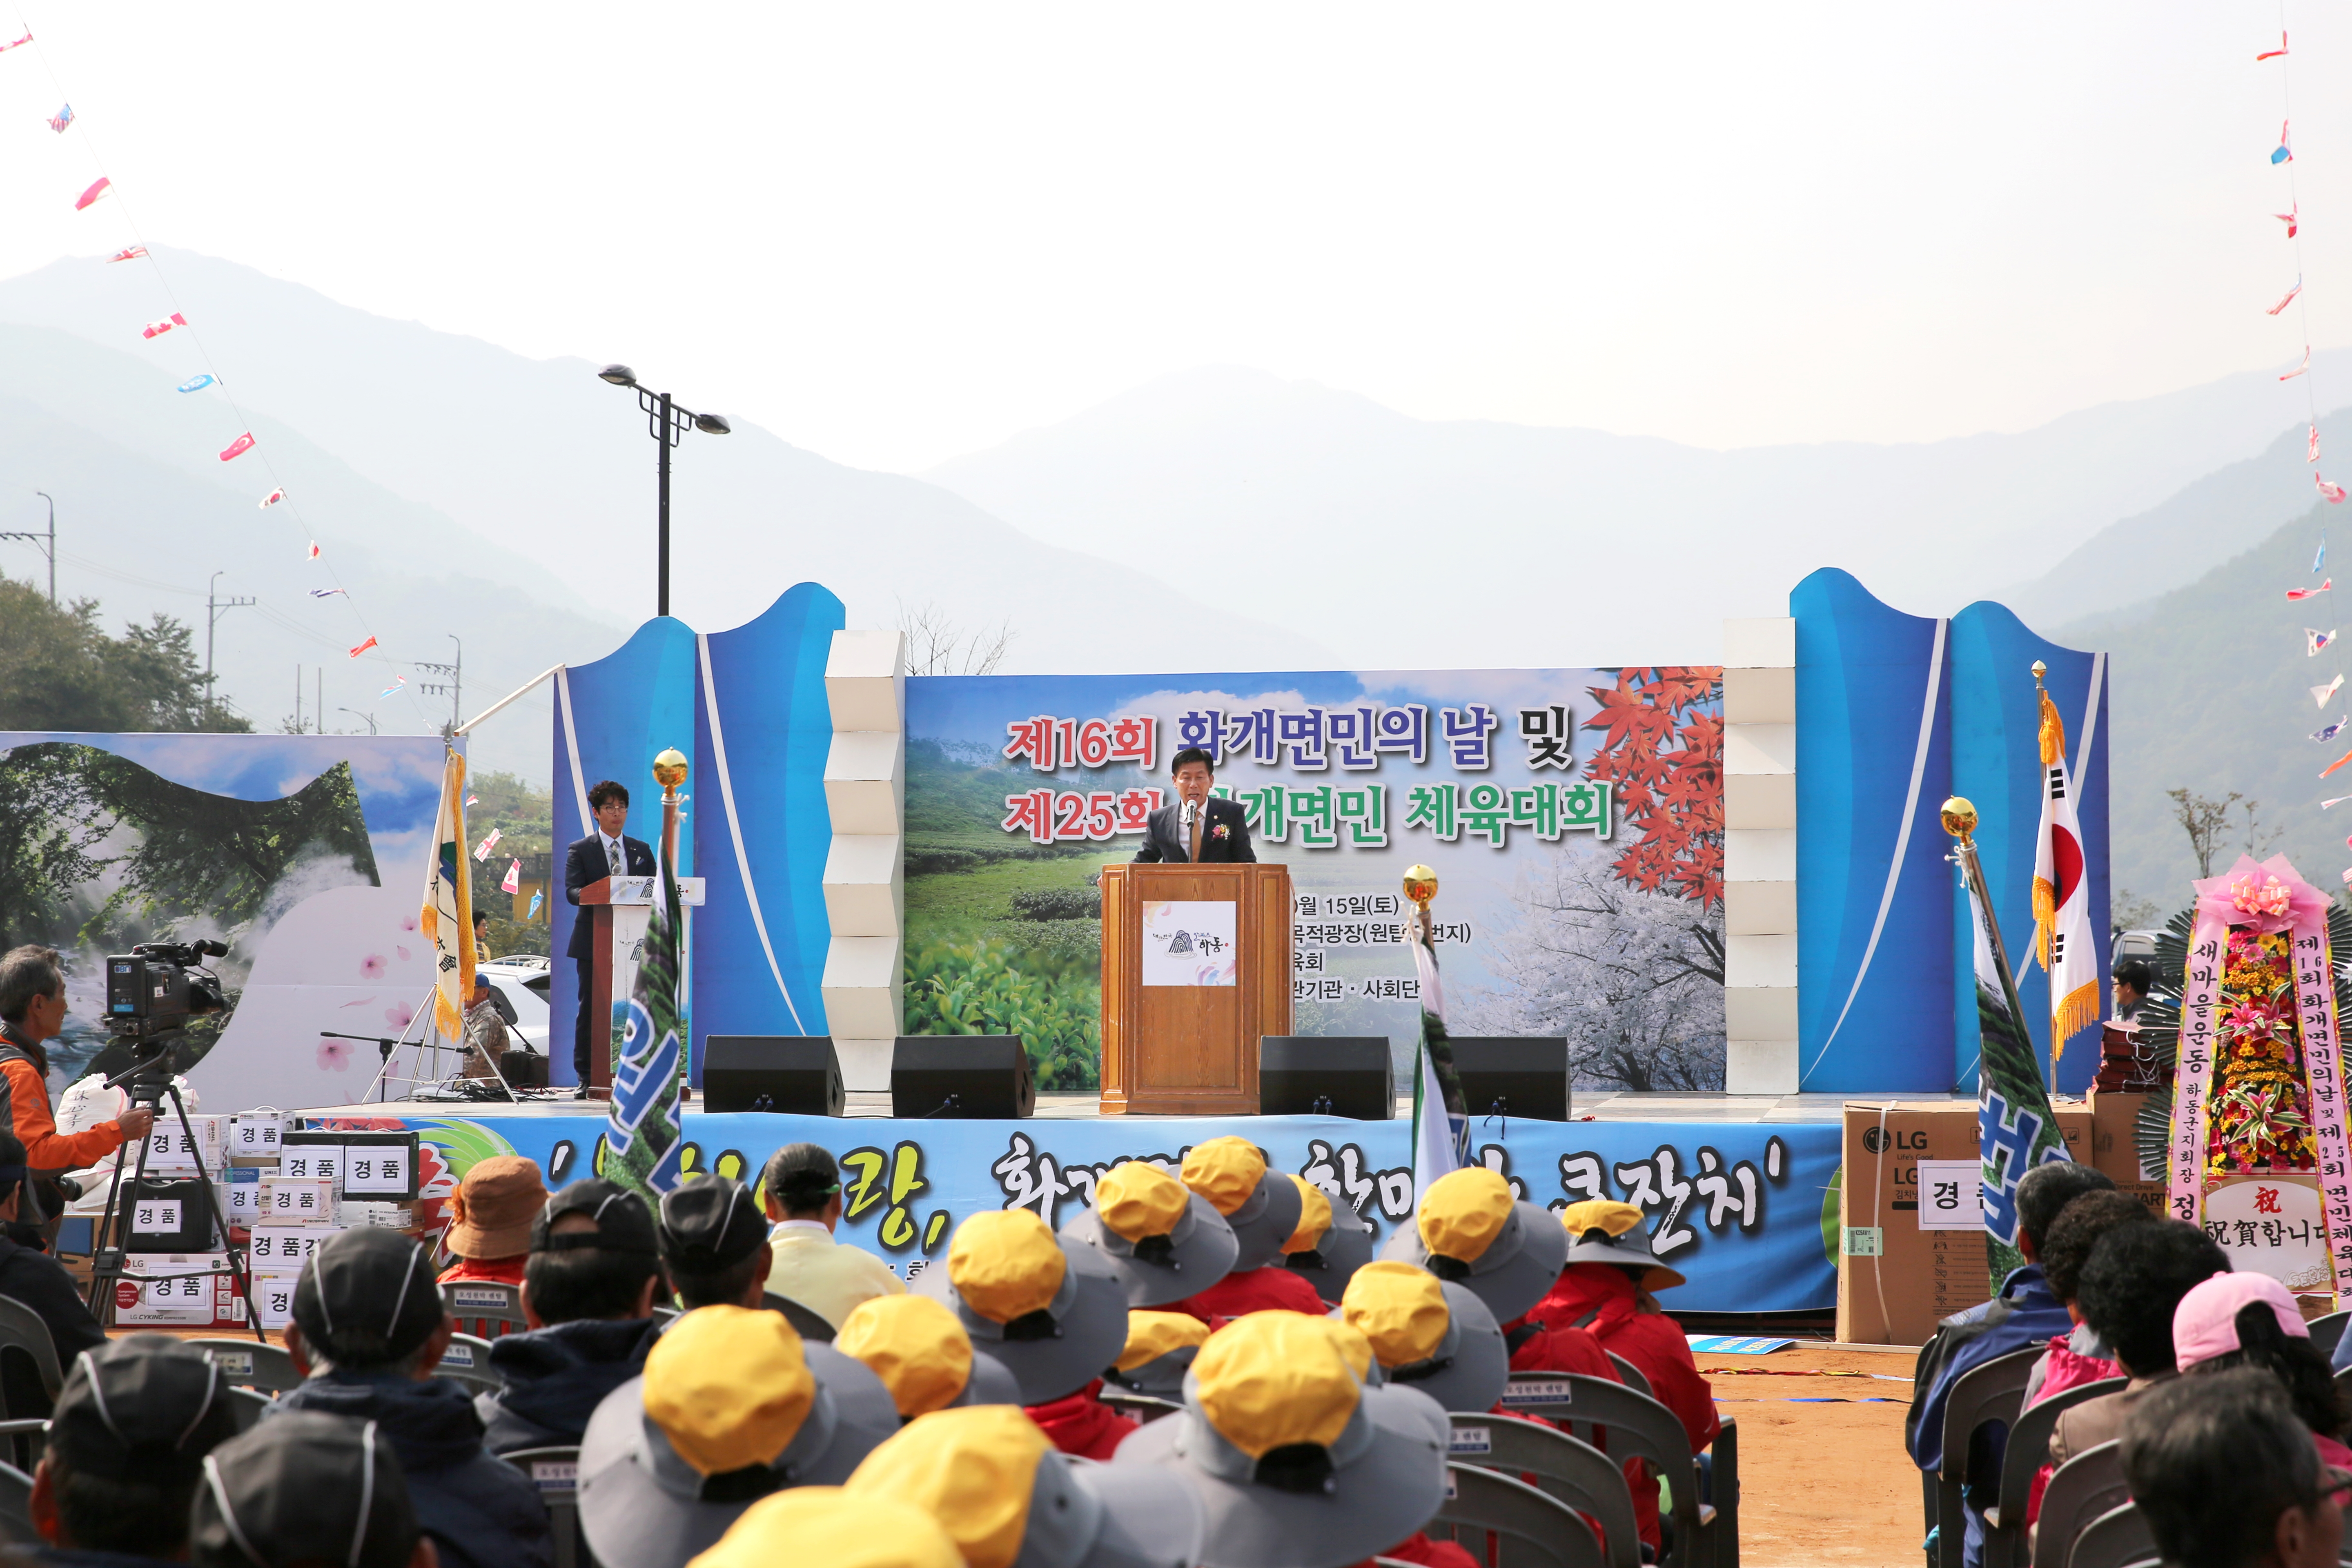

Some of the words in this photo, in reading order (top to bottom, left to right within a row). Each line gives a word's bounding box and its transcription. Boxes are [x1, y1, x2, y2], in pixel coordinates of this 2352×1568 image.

[1007, 718, 1153, 767] 제16회
[1178, 707, 1423, 765] 화개면민의
[1443, 706, 1493, 765] 날
[1520, 706, 1568, 765] 및
[1006, 788, 1159, 840] 제25회
[1211, 785, 1385, 843] 개면민
[1405, 784, 1608, 843] 체육대회
[1326, 895, 1399, 915] 15일(토)
[1294, 923, 1471, 944] 목적광장(원탑번지)
[1199, 937, 1223, 956] 하동
[2183, 940, 2218, 1074] 새마을운동
[154, 1135, 169, 1153] 경
[243, 1128, 254, 1143] 경
[263, 1128, 277, 1143] 품
[1897, 1131, 1927, 1150] LG
[290, 1159, 306, 1176] 경
[316, 1159, 335, 1176] 품
[354, 1160, 371, 1179] 경
[381, 1160, 400, 1179] 품
[233, 1191, 245, 1207] 경
[277, 1192, 290, 1208] 경
[299, 1193, 314, 1208] 품
[1933, 1181, 1959, 1209] 경
[2252, 1186, 2282, 1214] 祝
[139, 1209, 152, 1224] 경
[161, 1209, 175, 1224] 품
[254, 1237, 271, 1256] 경
[282, 1238, 300, 1256] 품
[155, 1279, 171, 1296] 경
[183, 1277, 200, 1296] 품
[272, 1293, 287, 1312] 경
